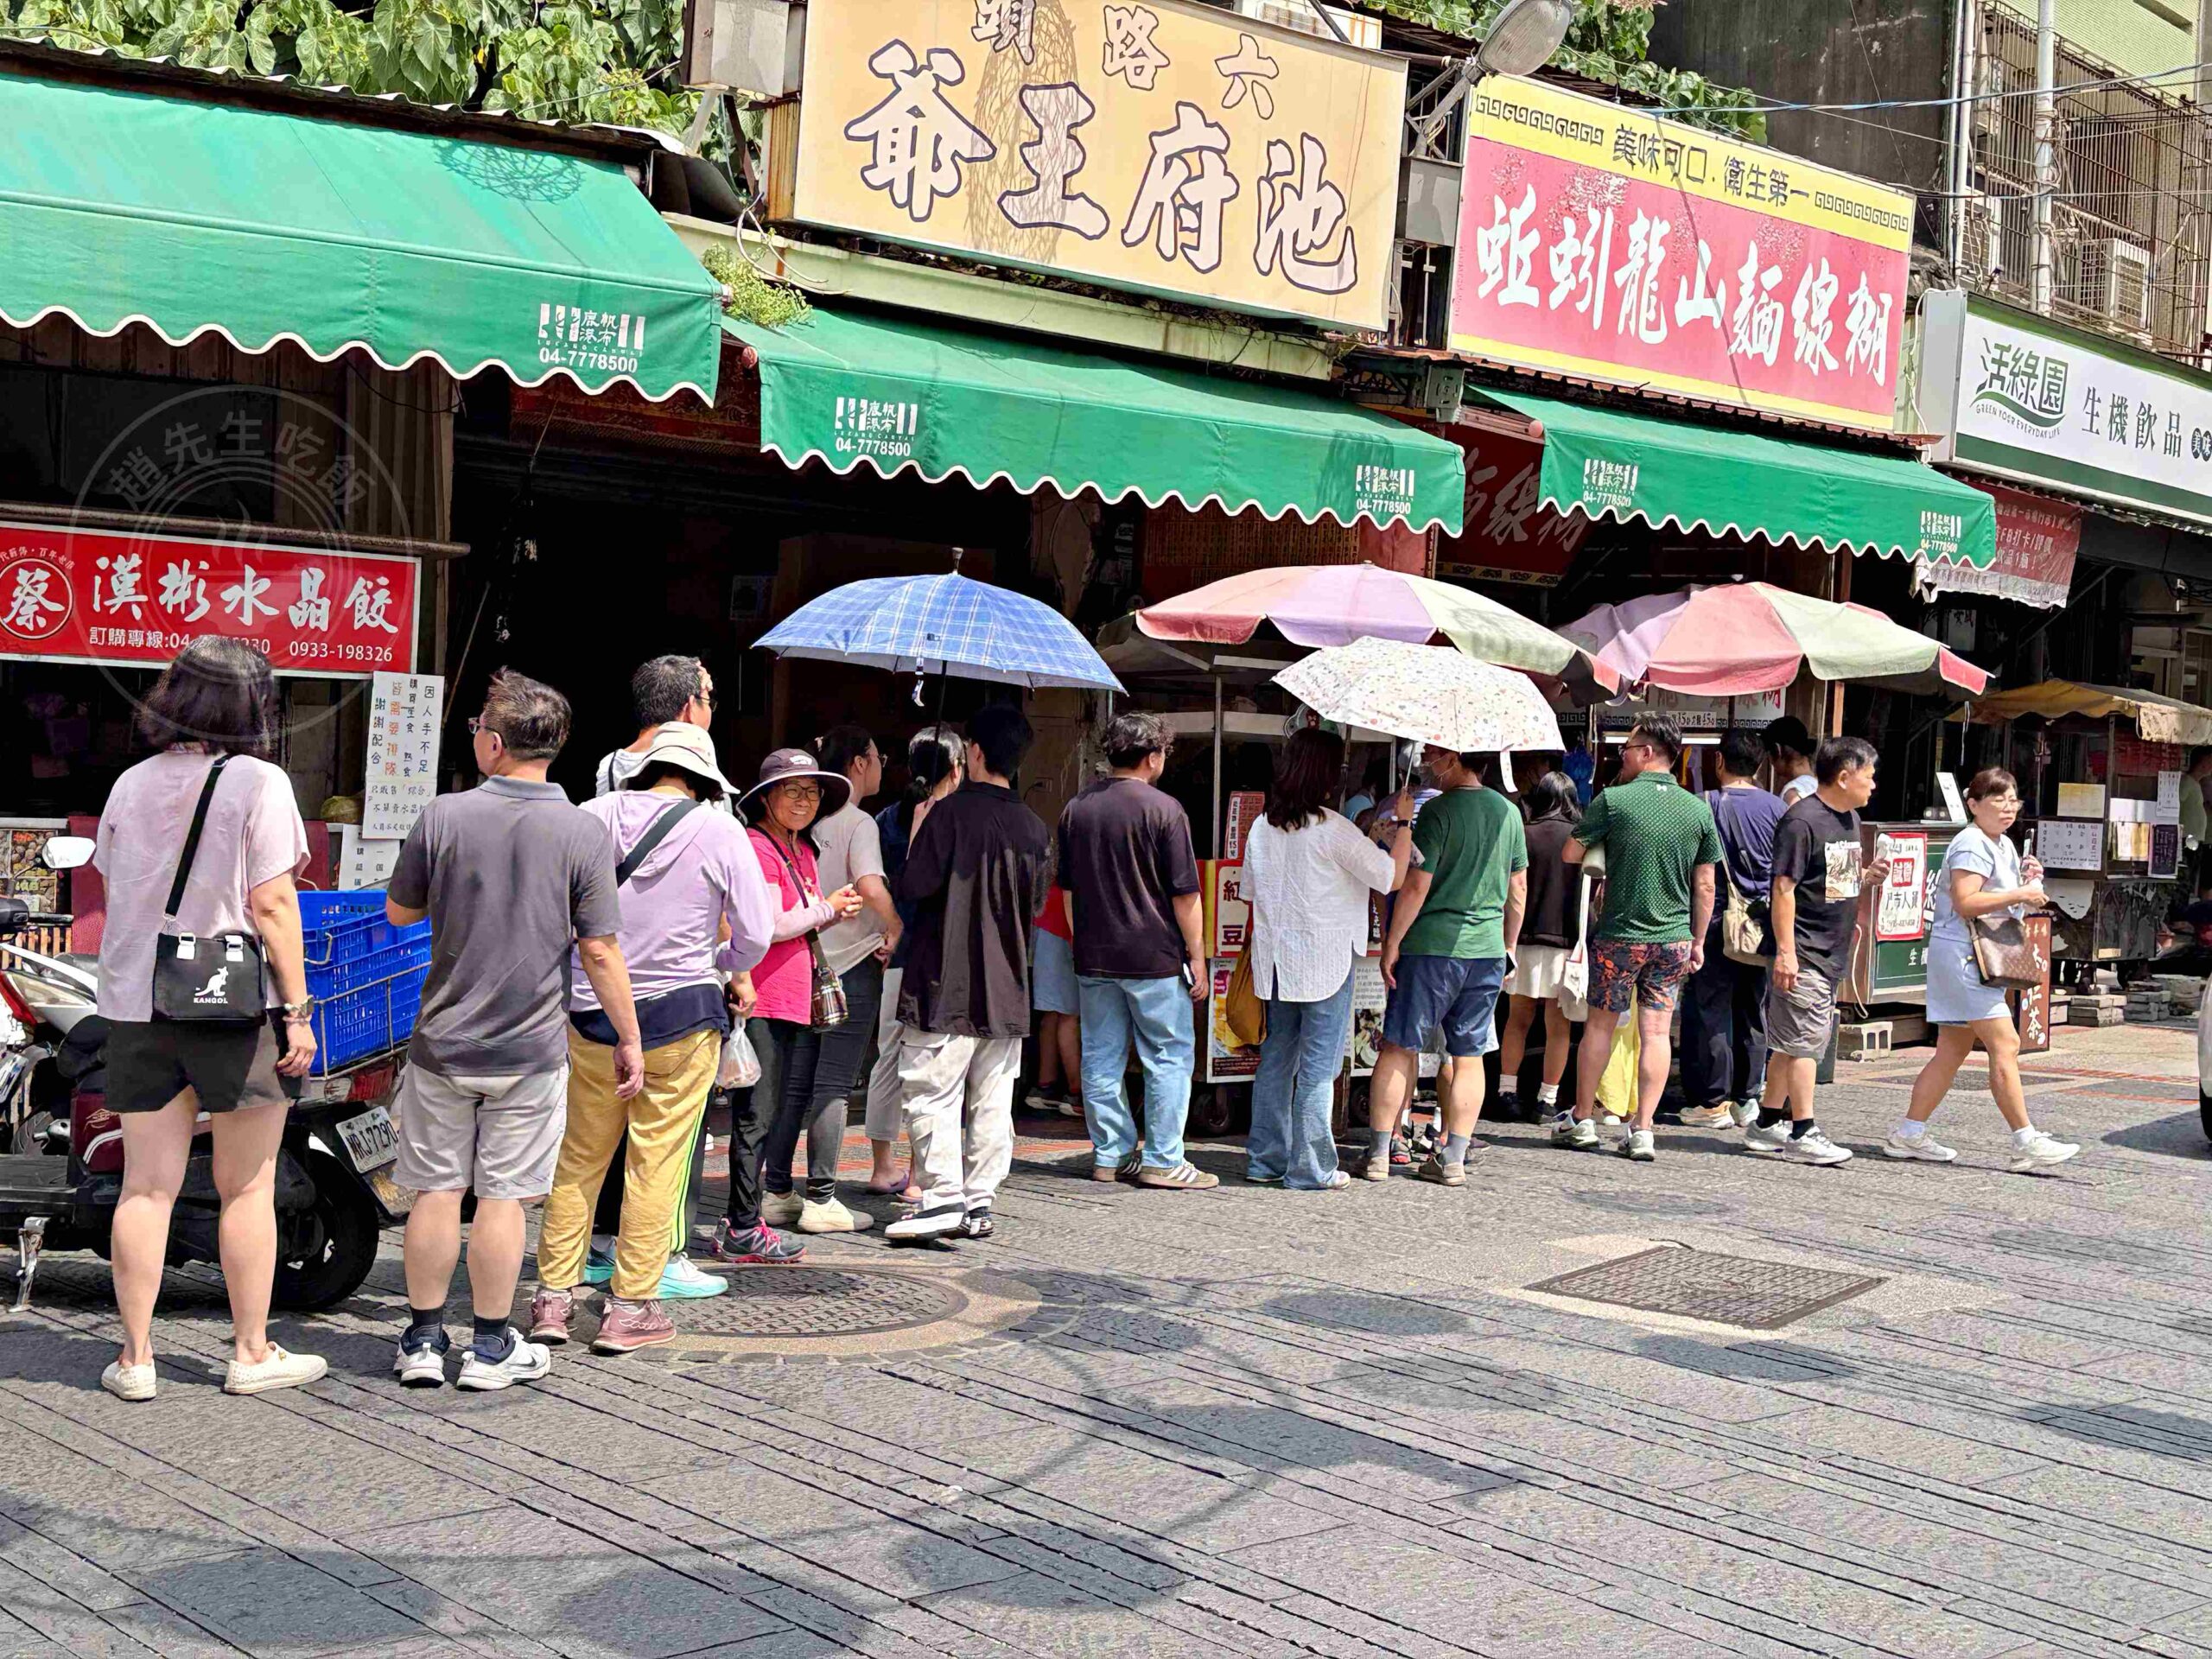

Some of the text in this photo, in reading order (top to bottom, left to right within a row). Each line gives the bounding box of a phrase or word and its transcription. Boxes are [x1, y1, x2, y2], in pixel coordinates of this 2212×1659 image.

[1475, 184, 1891, 387] 蚯蚓龍山麵線糊
[539, 347, 638, 373] 04-7778500
[1976, 337, 2069, 415] 活綠園
[1975, 404, 1997, 416] GREEN
[2082, 386, 2182, 458] 生機飲品
[836, 437, 911, 456] 04-7778500
[1357, 499, 1411, 514] 04-7778500
[1583, 491, 1631, 507] 04-7778500
[2, 568, 65, 632] 蔡
[92, 553, 398, 633] 漢彬水晶餃
[289, 641, 393, 663] 0933-198326
[418, 686, 435, 773] 因人手不足
